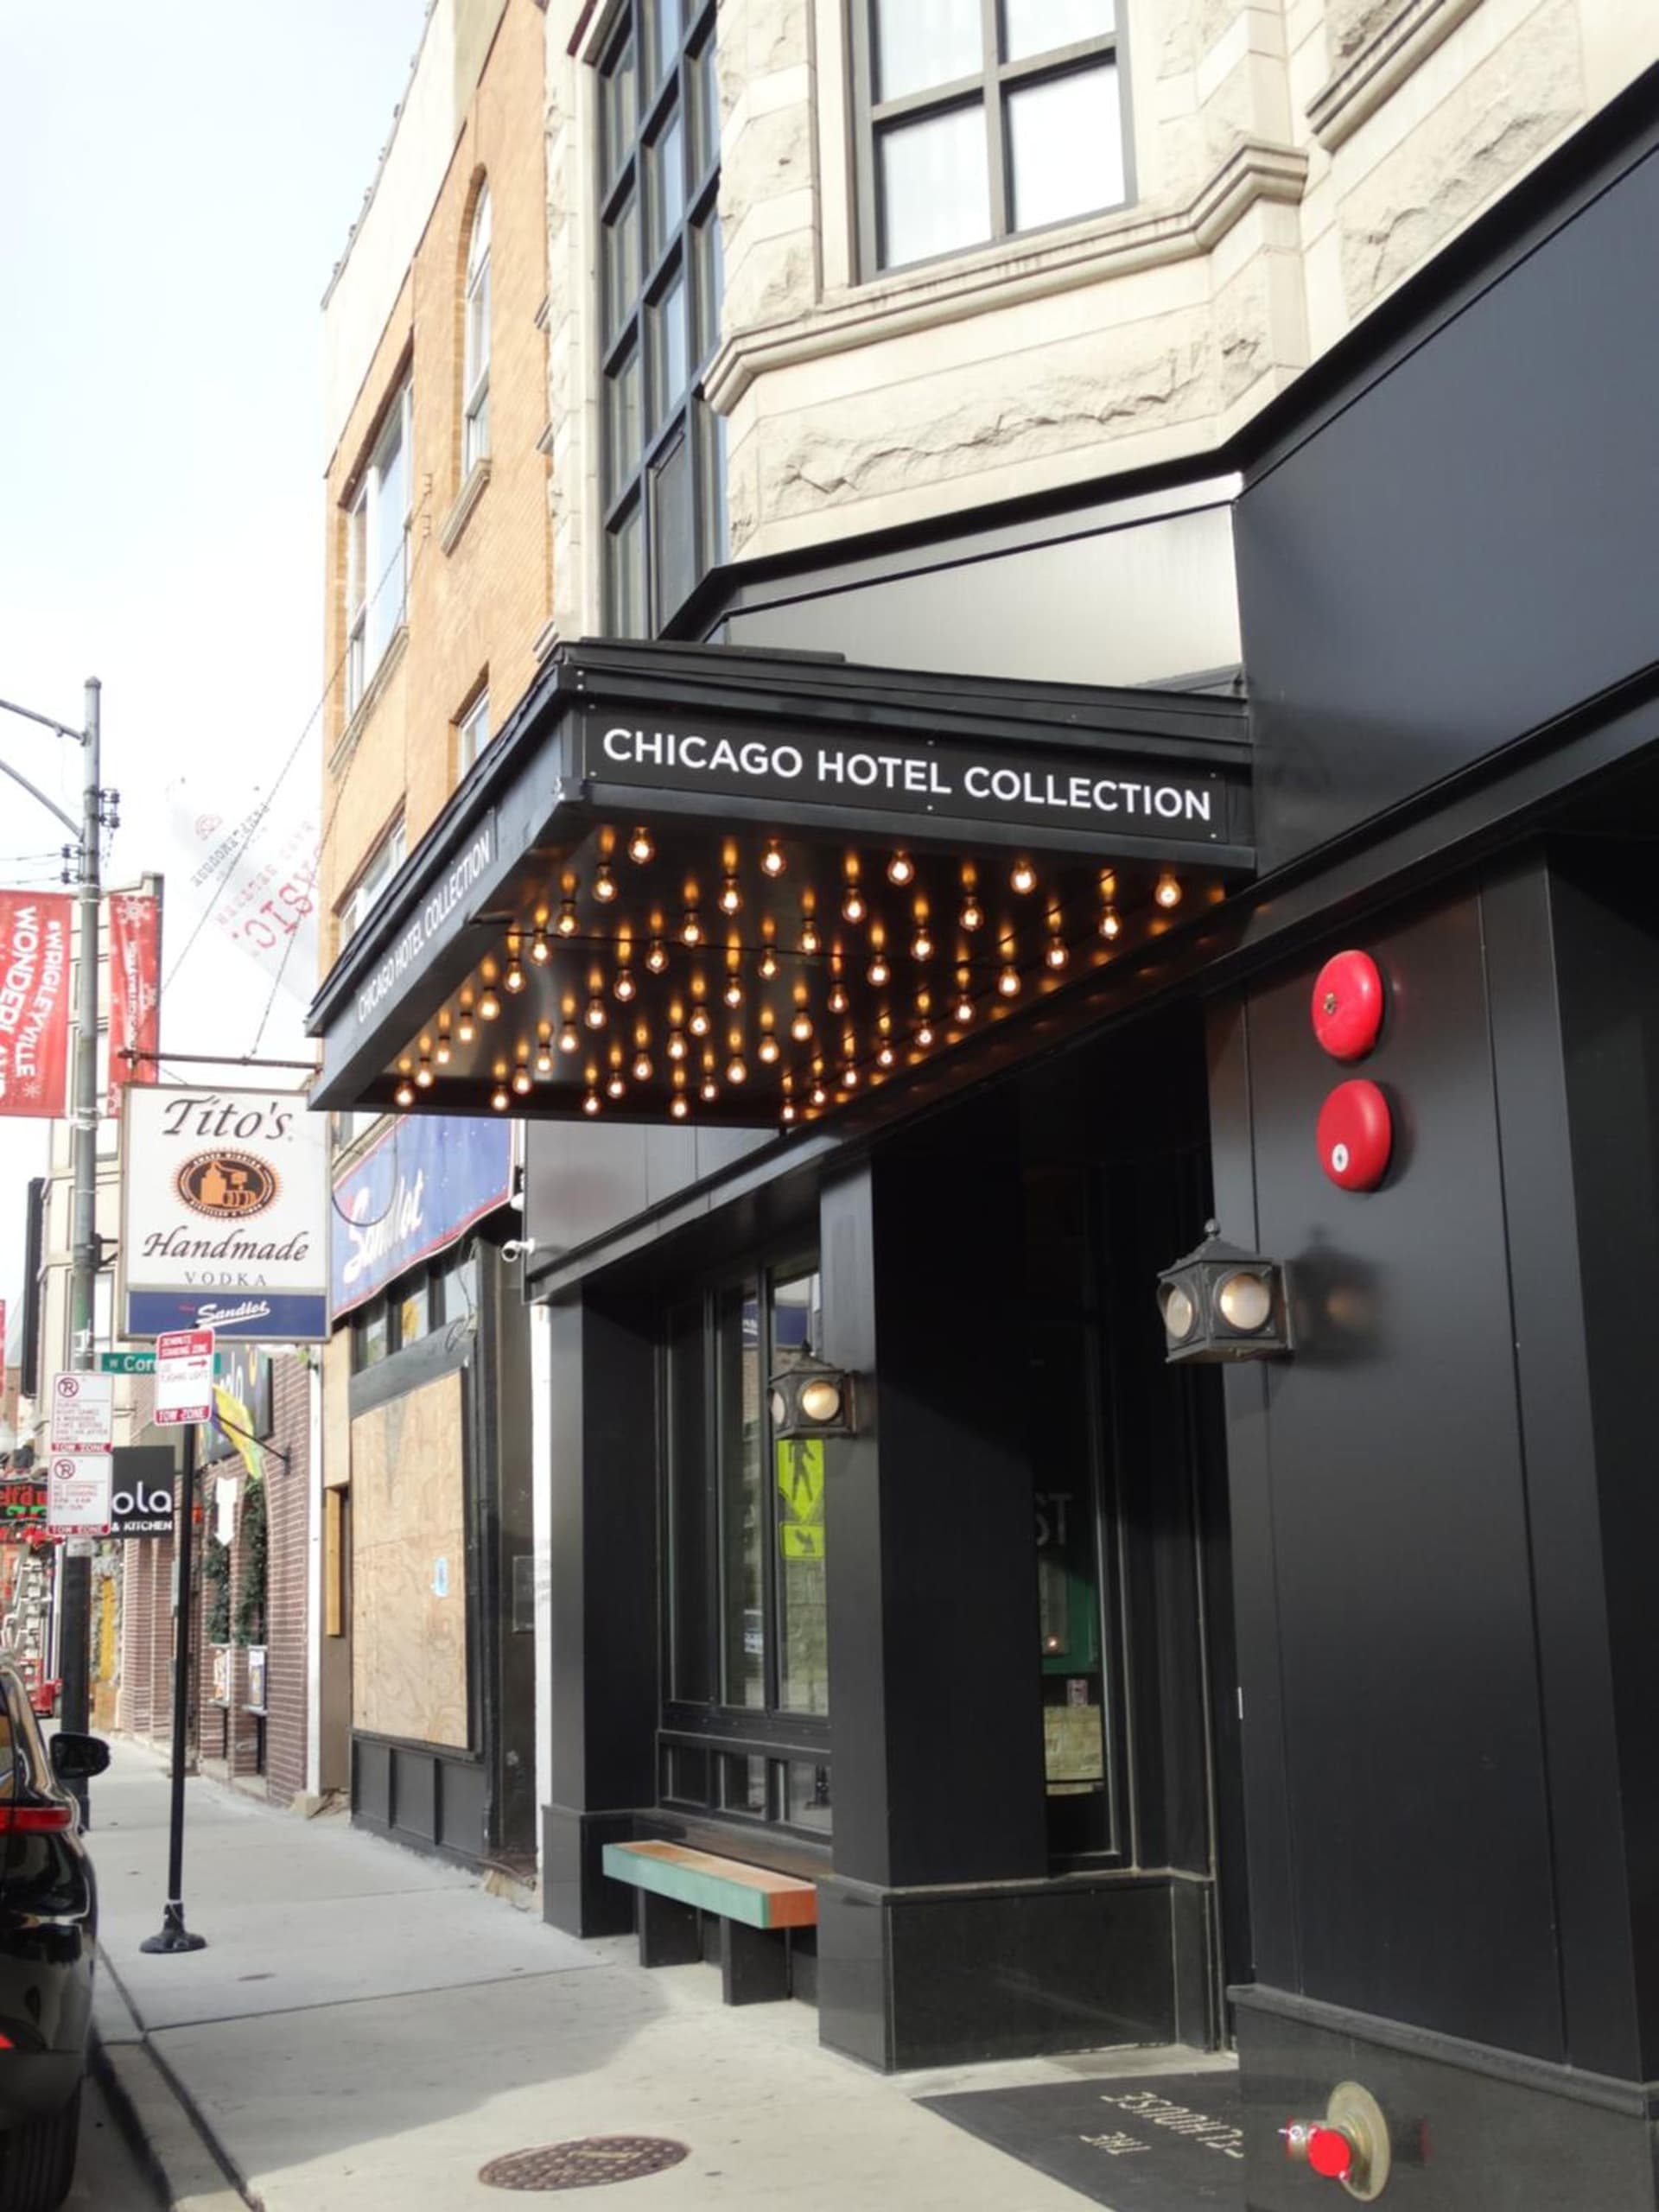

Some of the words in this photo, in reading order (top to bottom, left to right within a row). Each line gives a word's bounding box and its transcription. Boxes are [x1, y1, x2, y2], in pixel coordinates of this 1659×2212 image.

[603, 728, 803, 779] CHICAGO
[817, 751, 952, 795] HOTEL
[963, 766, 1212, 821] COLLECTION
[357, 956, 396, 1024] CHICAGO
[394, 925, 425, 976] HOTEL
[423, 830, 491, 938] COLLECTION
[0, 905, 38, 1098] WONDER
[162, 1095, 294, 1141] Tito's
[141, 1224, 309, 1262] Handmade
[183, 1271, 267, 1287] VODKA
[196, 1300, 270, 1327] Sandlot
[181, 1408, 205, 1420] ZONE
[112, 1481, 172, 1515] ola
[123, 1520, 173, 1532] KITCHEN
[1078, 2131, 1152, 2157] THE
